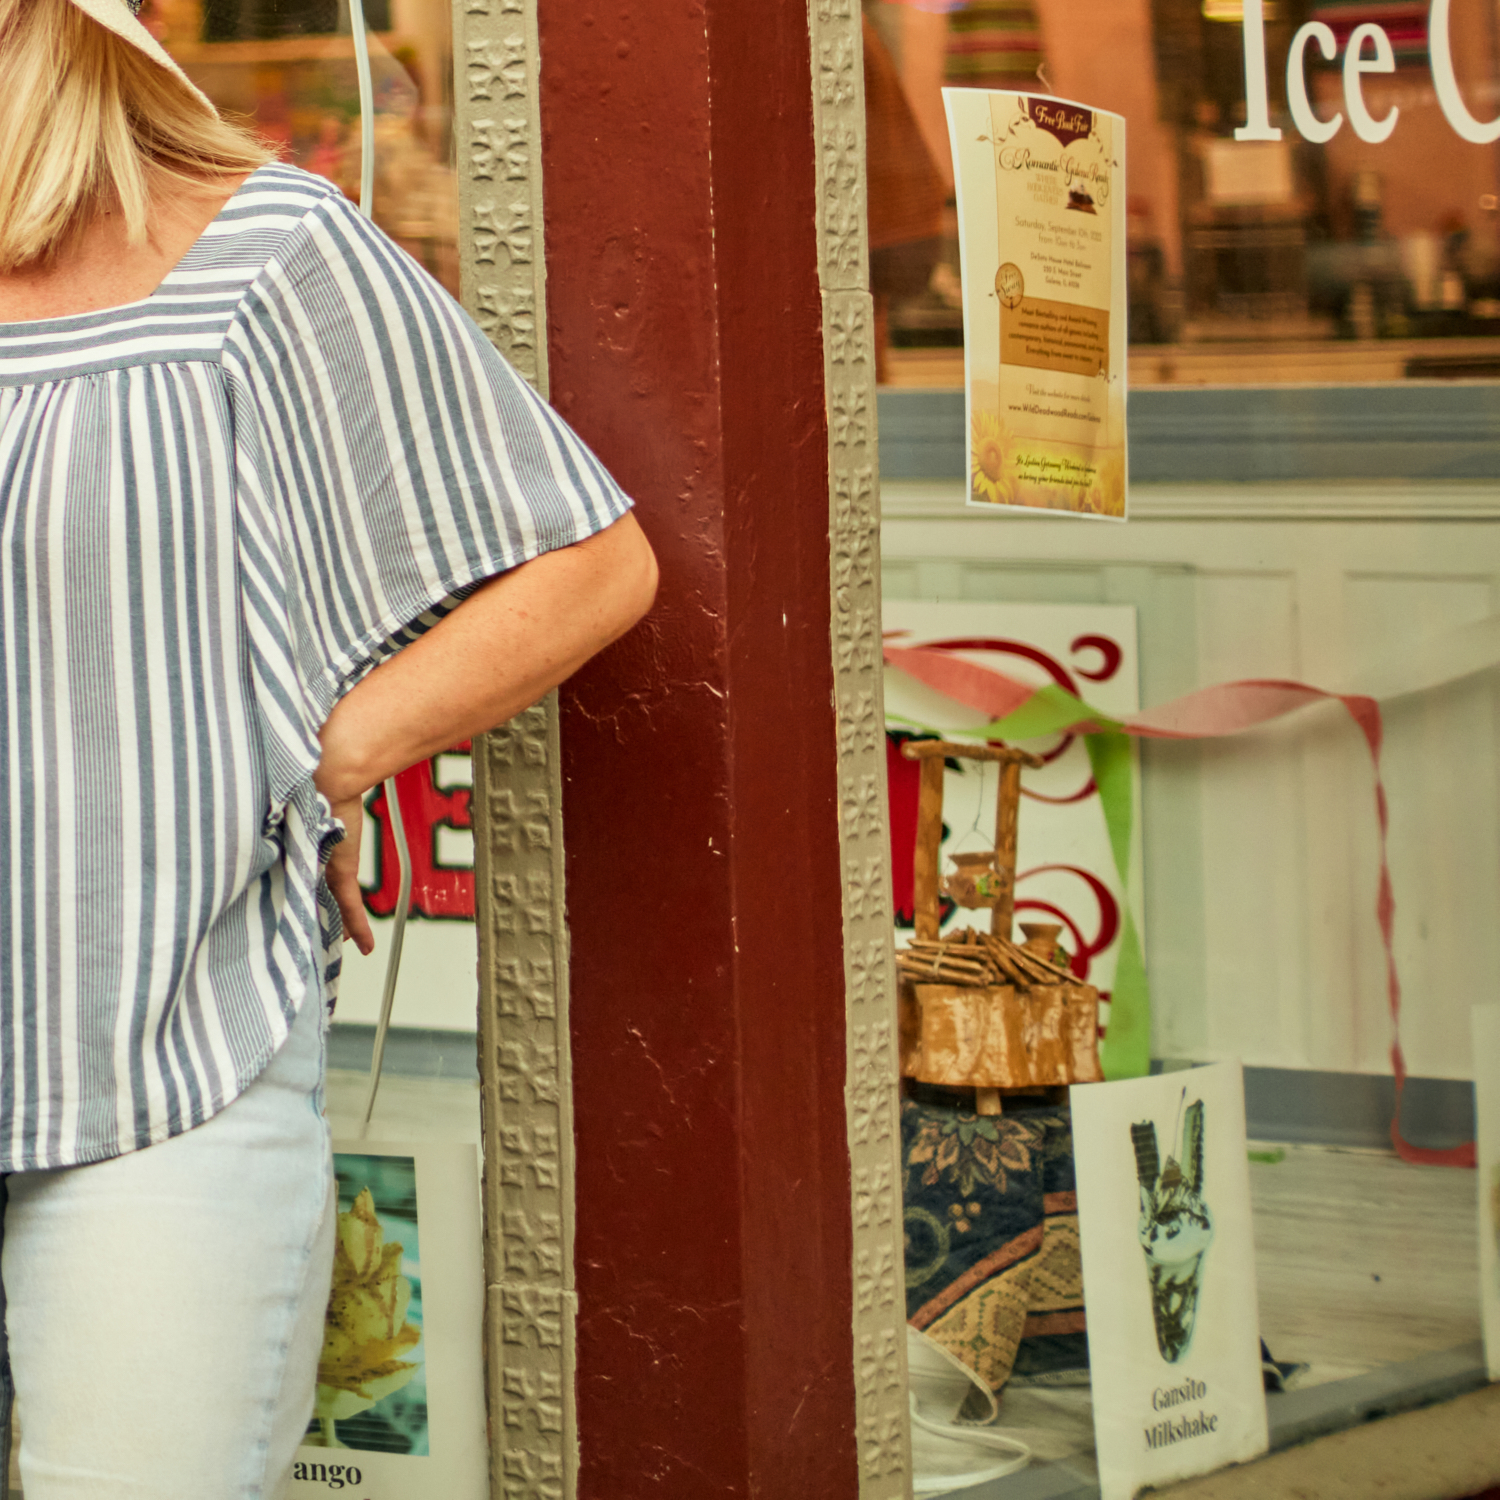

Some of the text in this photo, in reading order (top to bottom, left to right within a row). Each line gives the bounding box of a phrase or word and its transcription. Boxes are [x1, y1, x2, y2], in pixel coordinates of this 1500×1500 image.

[1153, 1377, 1206, 1412] Gansito
[1144, 1410, 1218, 1451] Milkshake
[293, 1461, 362, 1489] ango
